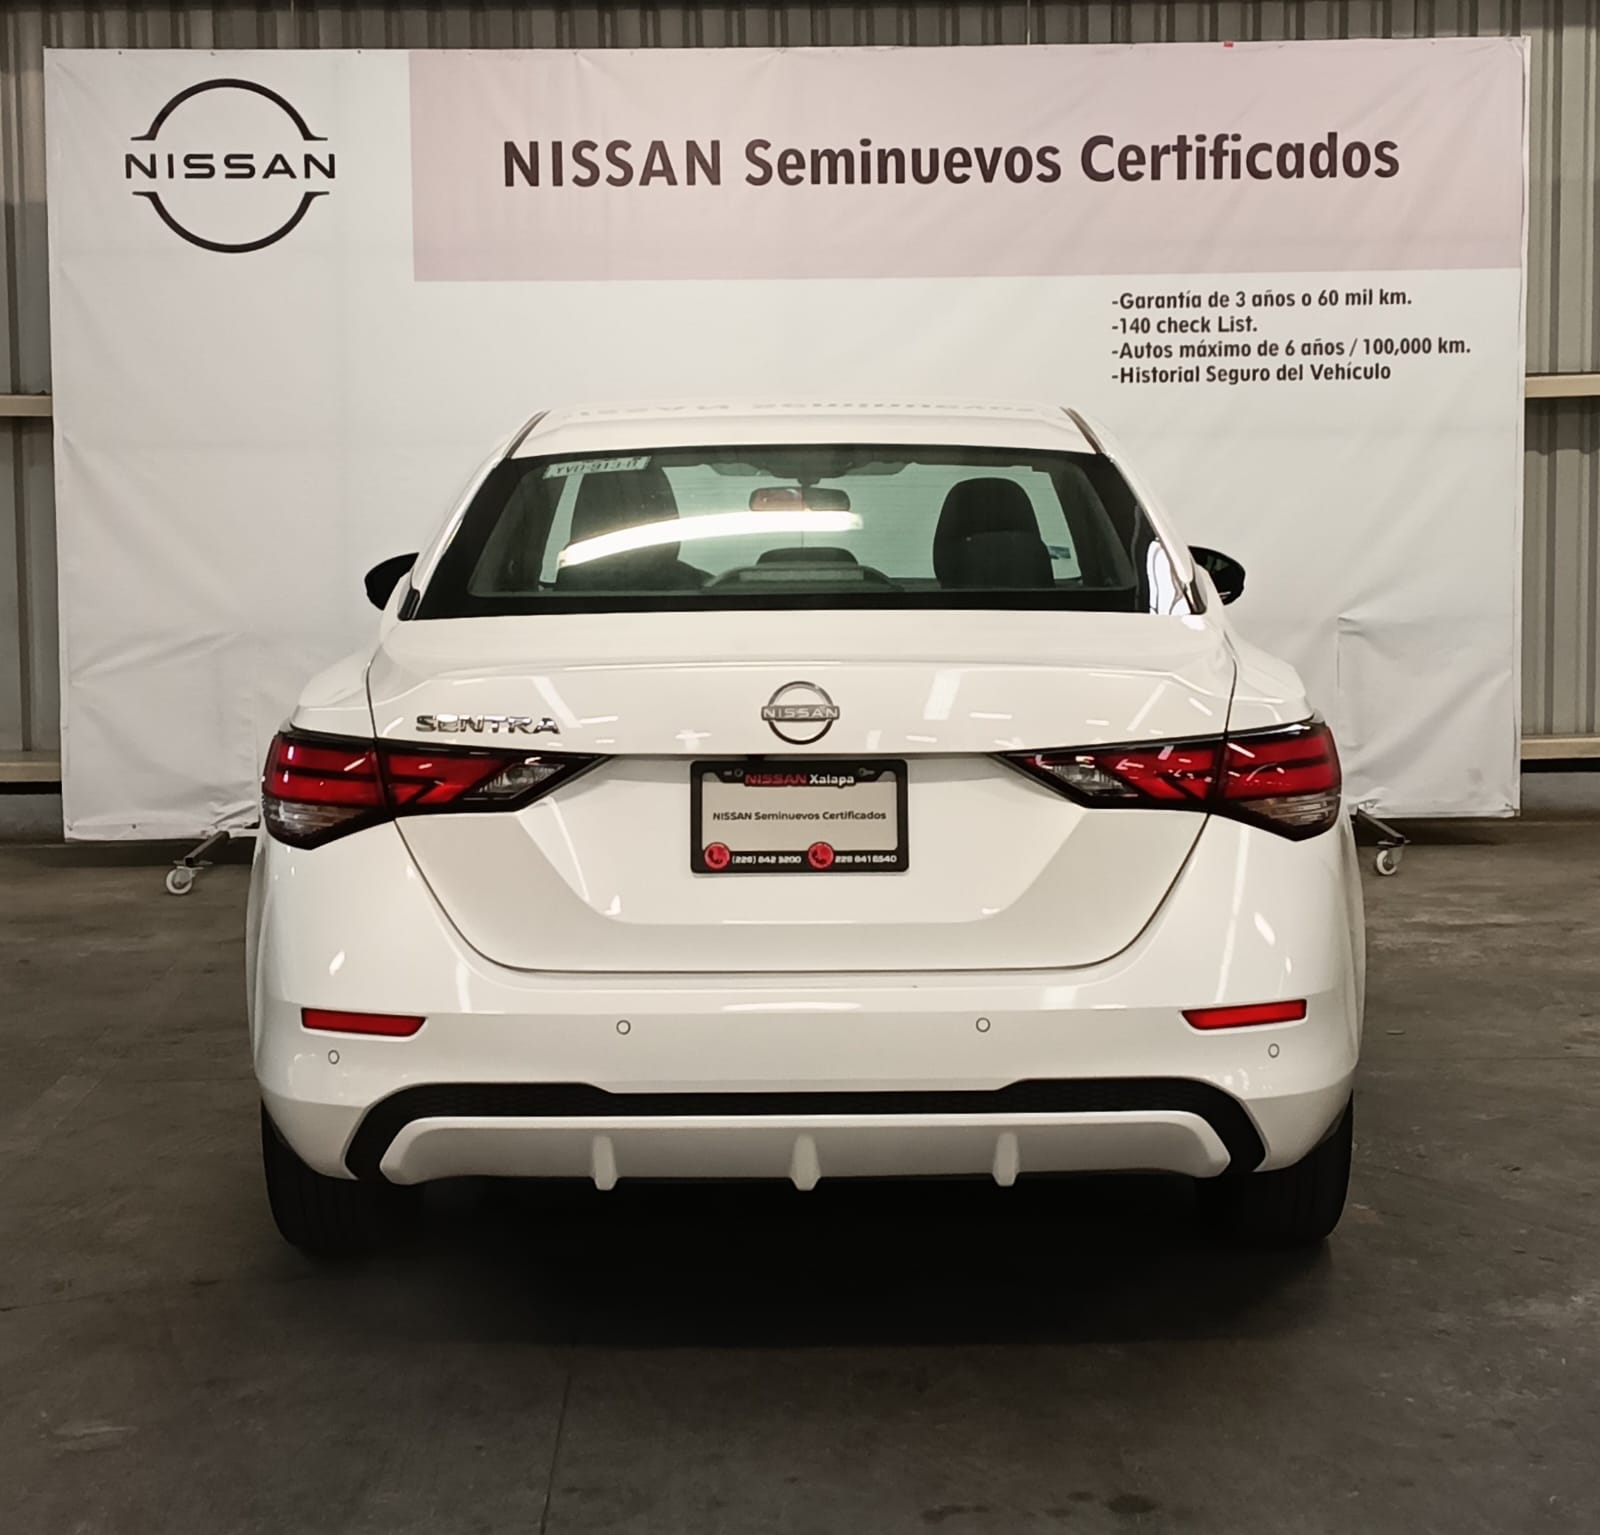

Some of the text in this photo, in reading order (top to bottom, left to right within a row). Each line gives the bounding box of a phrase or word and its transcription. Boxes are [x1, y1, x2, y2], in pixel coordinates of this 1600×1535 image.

[124, 153, 336, 180] NISSAN
[503, 131, 1400, 188] NISSAN Seminuevos Certificados
[1111, 288, 1412, 310] -Garantía de 3 años o 60 mil km.
[1111, 315, 1258, 335] -140 check List.
[1111, 336, 1471, 359] -Autos máximo de 6 años / 100,000 km.
[1111, 362, 1391, 386] -Historial Seguro del Vehículo
[763, 706, 837, 720] NISSAN
[415, 714, 561, 735] SENTRA
[745, 774, 855, 786] NISSAN Xalapa
[712, 810, 887, 821] NISSAN Seminuevos Certificados
